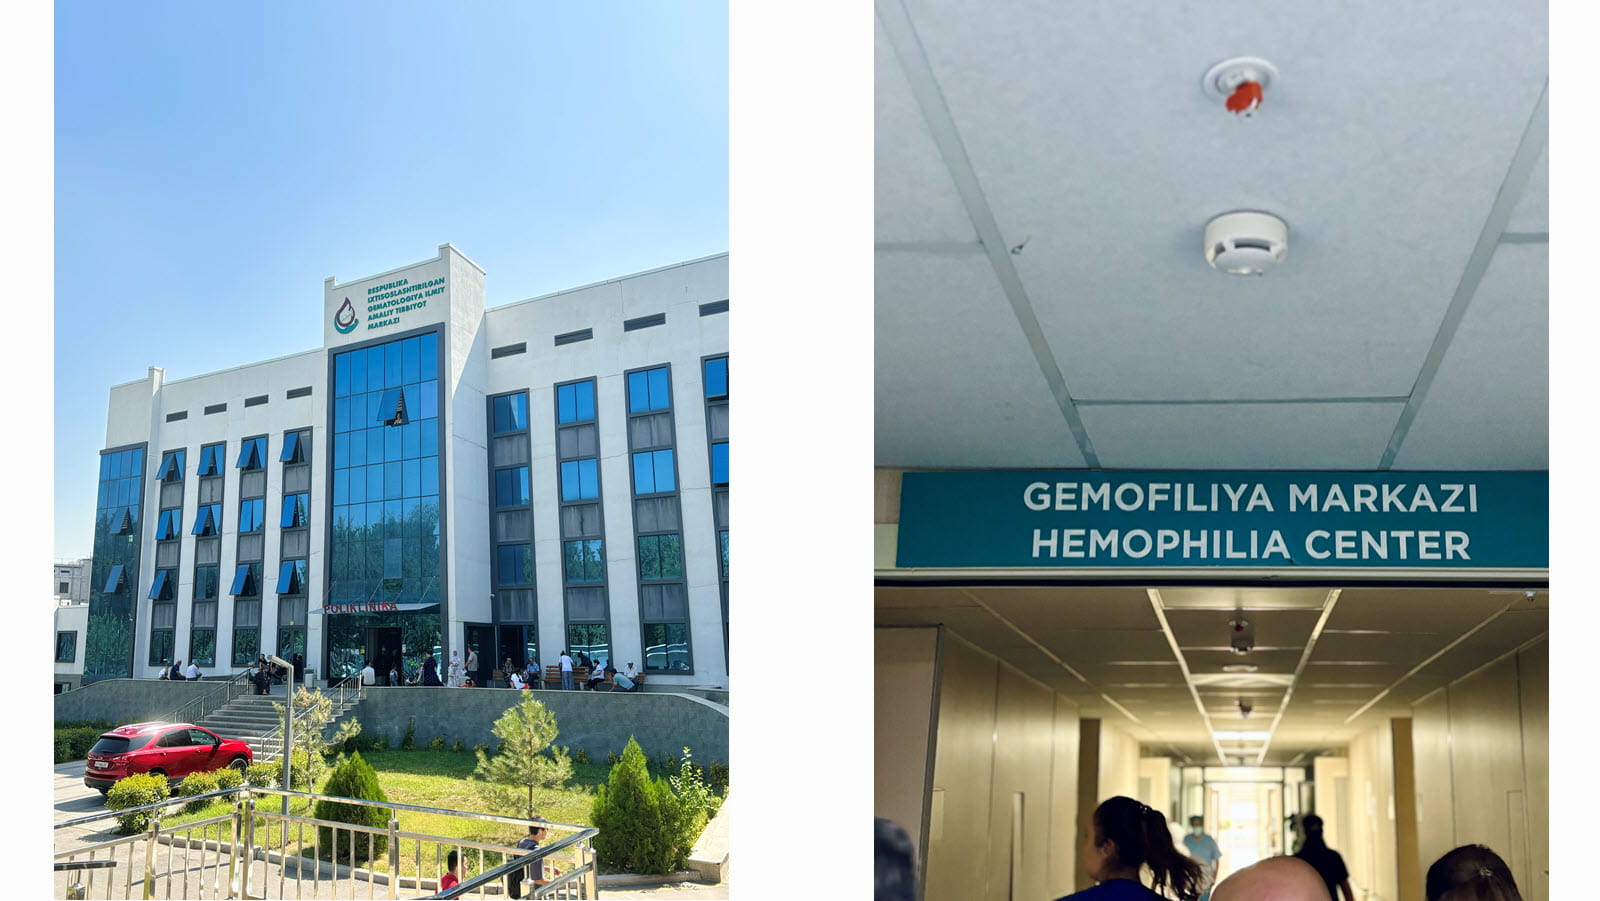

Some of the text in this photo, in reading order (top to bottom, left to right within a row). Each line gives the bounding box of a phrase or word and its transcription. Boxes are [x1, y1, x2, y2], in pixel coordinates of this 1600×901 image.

[368, 279, 408, 295] RESPUBLIKA
[368, 277, 445, 303] IXTISOSLASHTIRILGAN
[368, 287, 445, 312] GEMATOLOGIYA ILMIY
[368, 300, 427, 321] AMALIY TIBBIYOT
[368, 317, 400, 330] MARKAZI
[1023, 482, 1478, 513] GEMOFILIYA MARKAZI
[1032, 529, 1471, 560] HEMOPHILIA CENTER
[322, 602, 398, 615] POLIKLINIKA
